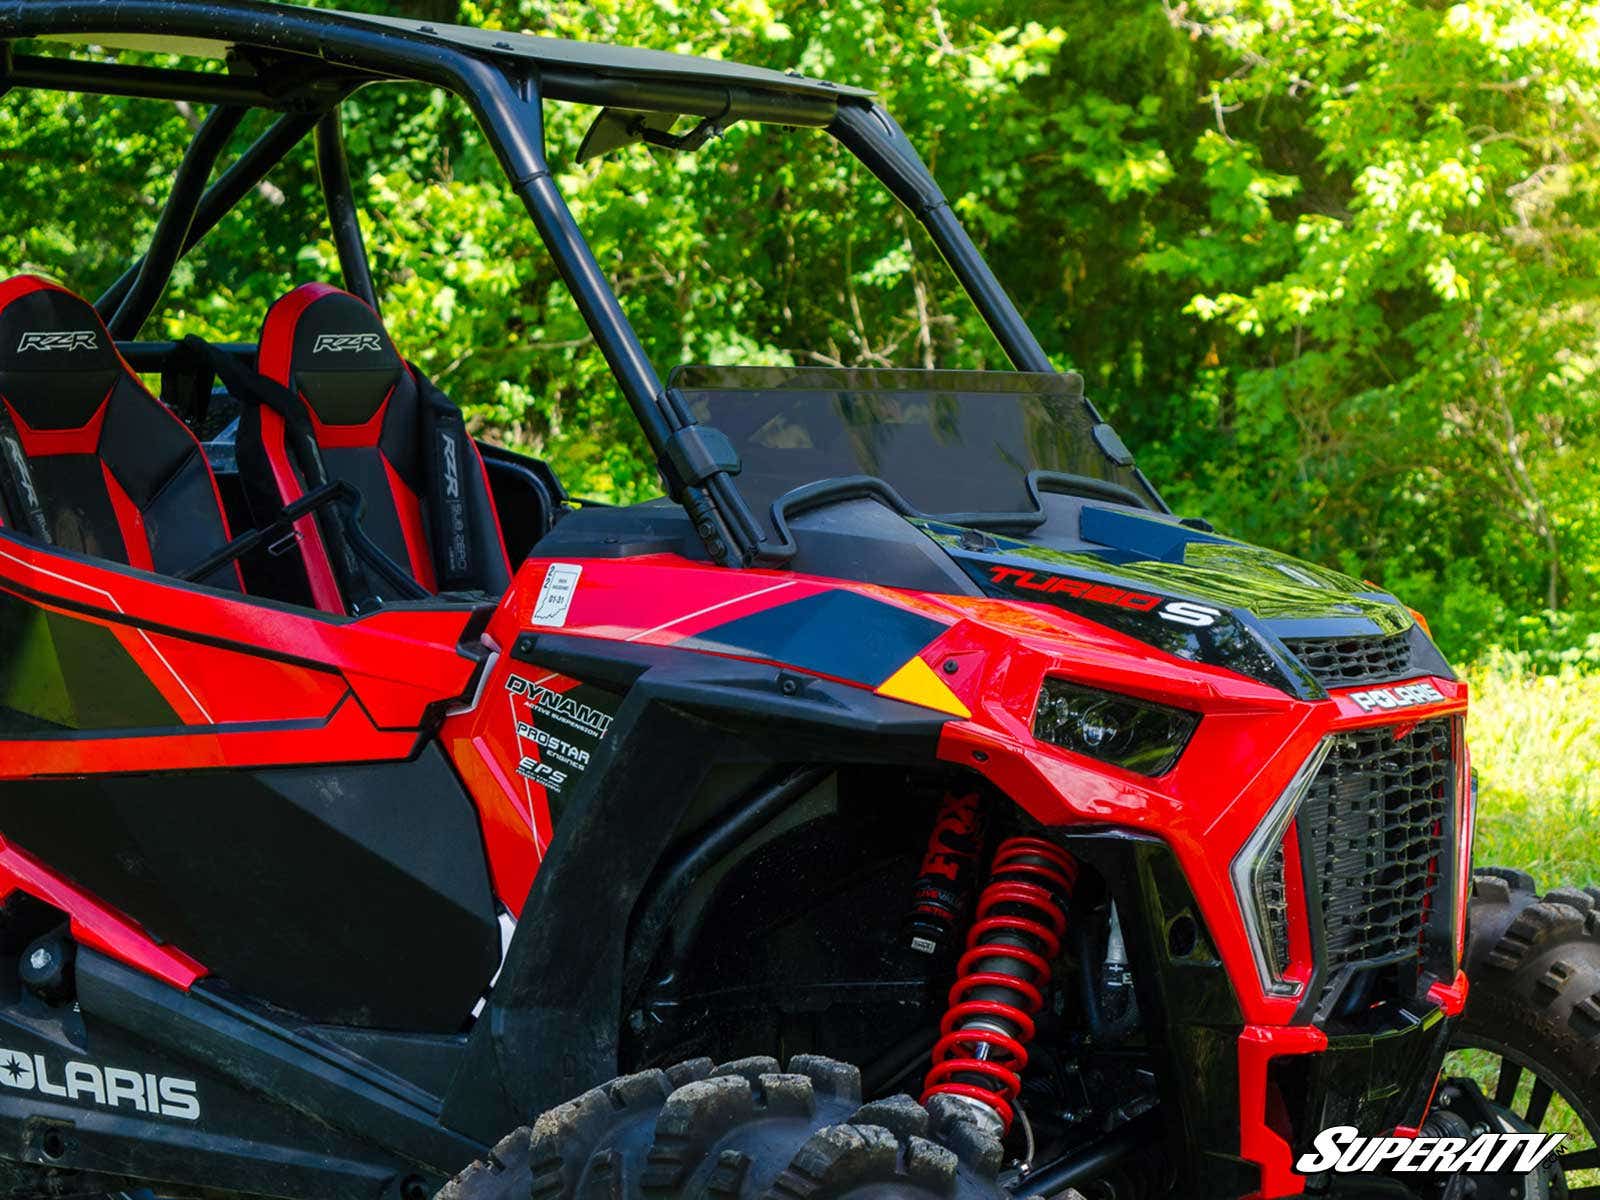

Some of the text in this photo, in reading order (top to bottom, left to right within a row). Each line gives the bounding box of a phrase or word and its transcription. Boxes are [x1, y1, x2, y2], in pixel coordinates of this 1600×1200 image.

[17, 331, 98, 353] RZR
[312, 333, 382, 354] RZR
[442, 433, 459, 498] RZR
[989, 565, 1222, 627] TURBO S
[505, 673, 613, 738] DYNAMI
[523, 701, 599, 737] ACTIVE SUSPENSION
[1348, 683, 1445, 712] POLARIS
[516, 721, 590, 764] PROSTAR
[519, 756, 568, 783] EPS
[918, 792, 984, 880] FOX
[0, 1048, 200, 1120] OLARIS
